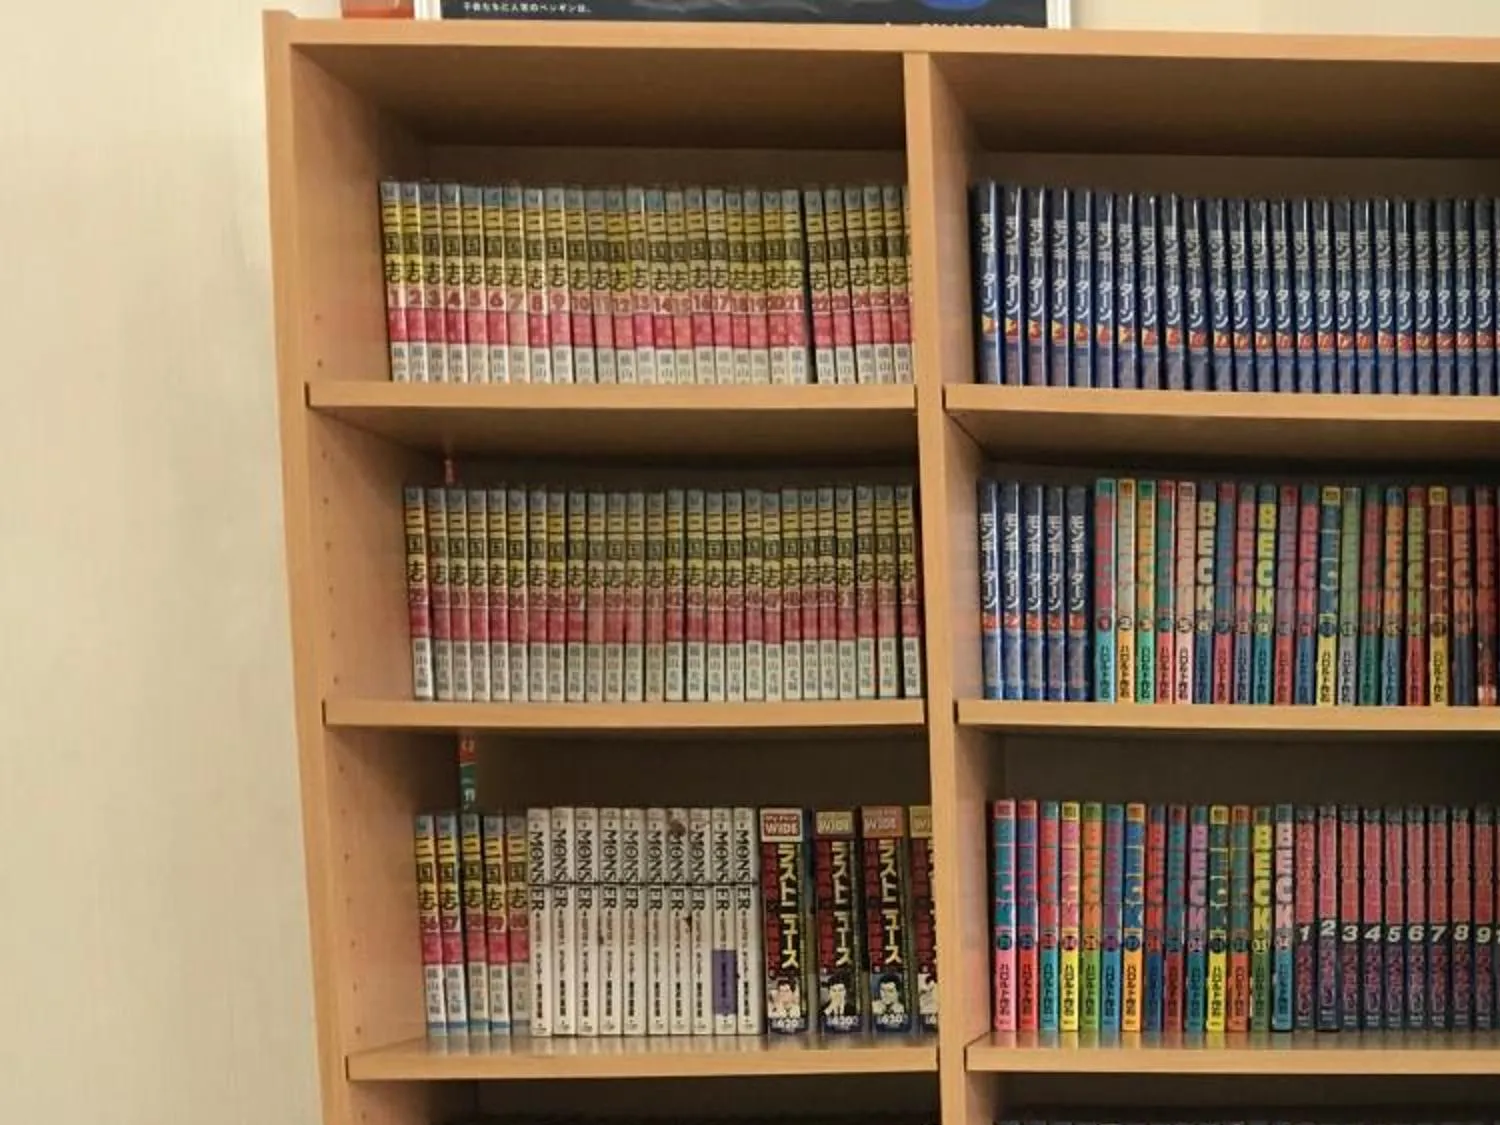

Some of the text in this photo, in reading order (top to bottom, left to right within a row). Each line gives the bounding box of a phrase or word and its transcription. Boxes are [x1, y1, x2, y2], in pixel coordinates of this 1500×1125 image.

[1300, 927, 1310, 942] 1
[1321, 920, 1336, 936] 2
[1342, 926, 1358, 942] 3
[1364, 926, 1380, 942] 4
[1387, 926, 1402, 942] 5
[1408, 925, 1424, 942] 6
[1430, 926, 1447, 942] 7
[1454, 924, 1469, 940] 8
[1476, 927, 1491, 943] 9
